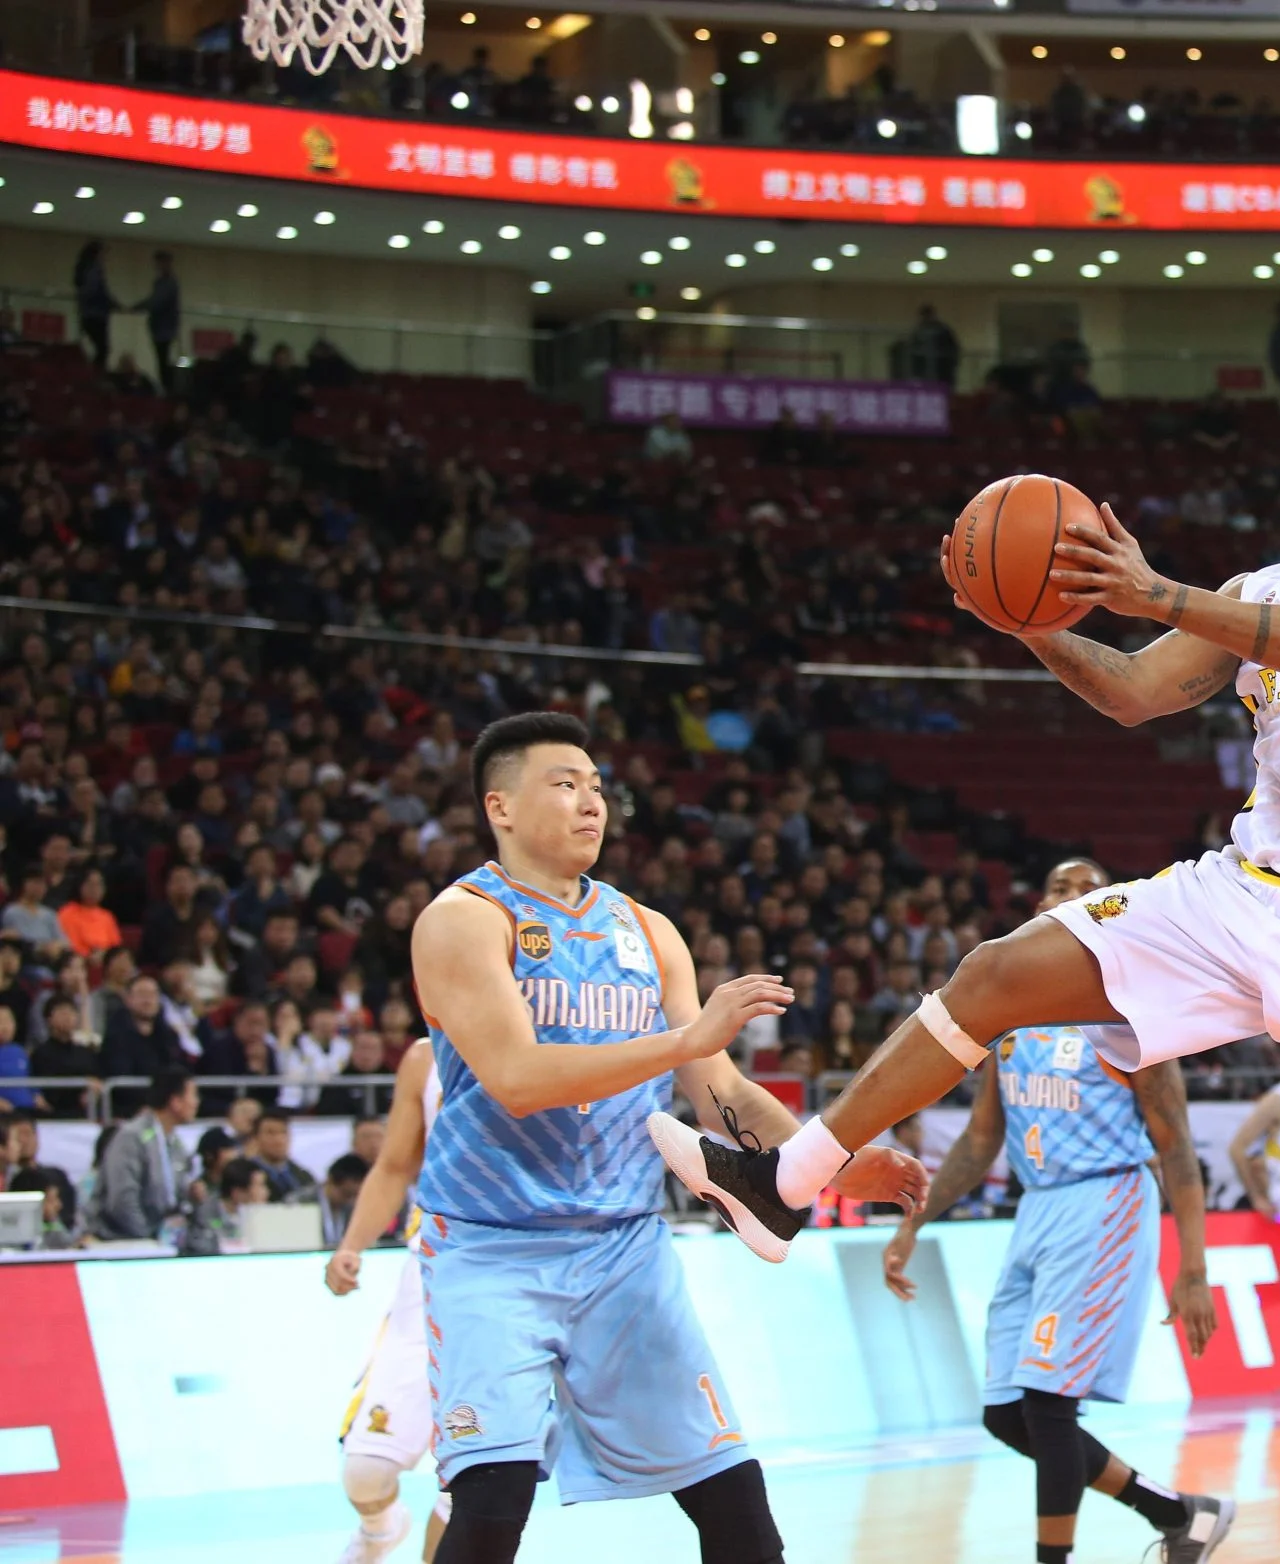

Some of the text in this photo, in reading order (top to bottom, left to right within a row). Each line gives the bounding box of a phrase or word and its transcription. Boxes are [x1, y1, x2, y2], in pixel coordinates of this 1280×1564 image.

[26, 97, 252, 155] 我的CBA 我的梦想
[520, 931, 550, 955] ups
[1024, 1123, 1045, 1169] 4
[1033, 1312, 1058, 1357] 4
[698, 1374, 728, 1429] 1
